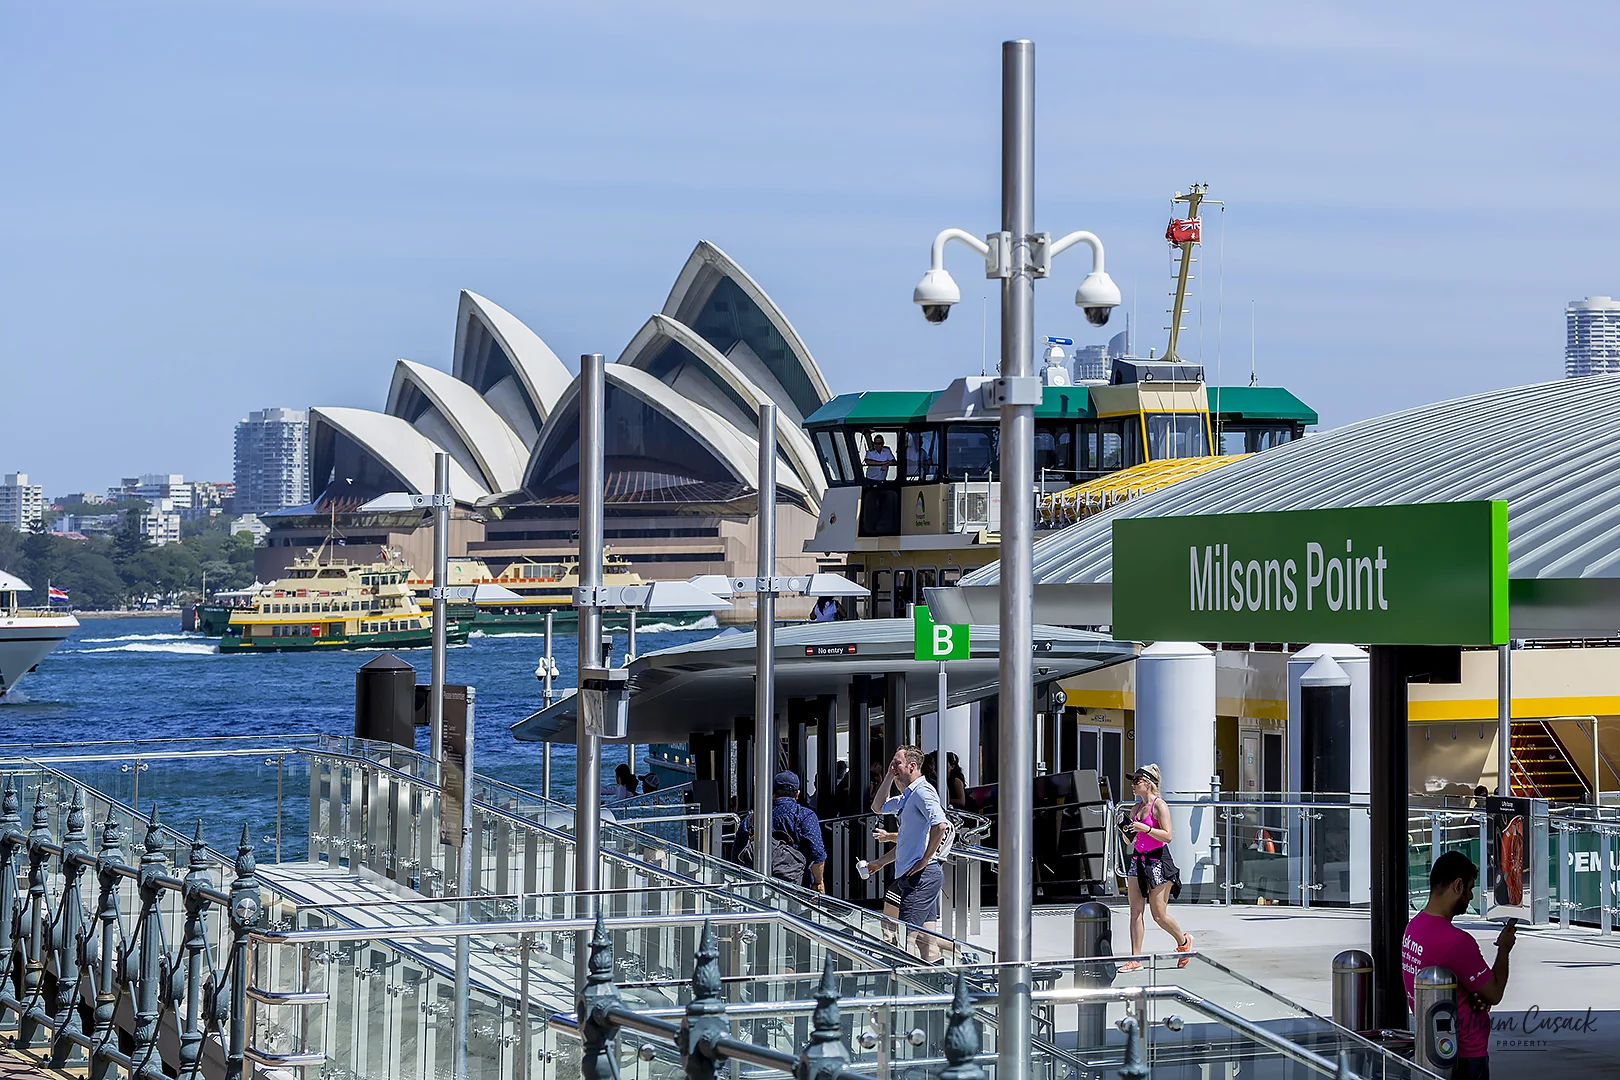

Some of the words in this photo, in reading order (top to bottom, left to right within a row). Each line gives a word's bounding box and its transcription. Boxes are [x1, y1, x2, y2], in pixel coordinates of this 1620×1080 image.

[1189, 543, 1298, 613] Milsons
[1305, 538, 1388, 613] Point
[818, 647, 826, 655] No
[827, 647, 844, 656] entry
[932, 624, 954, 656] B
[1411, 941, 1423, 956] me
